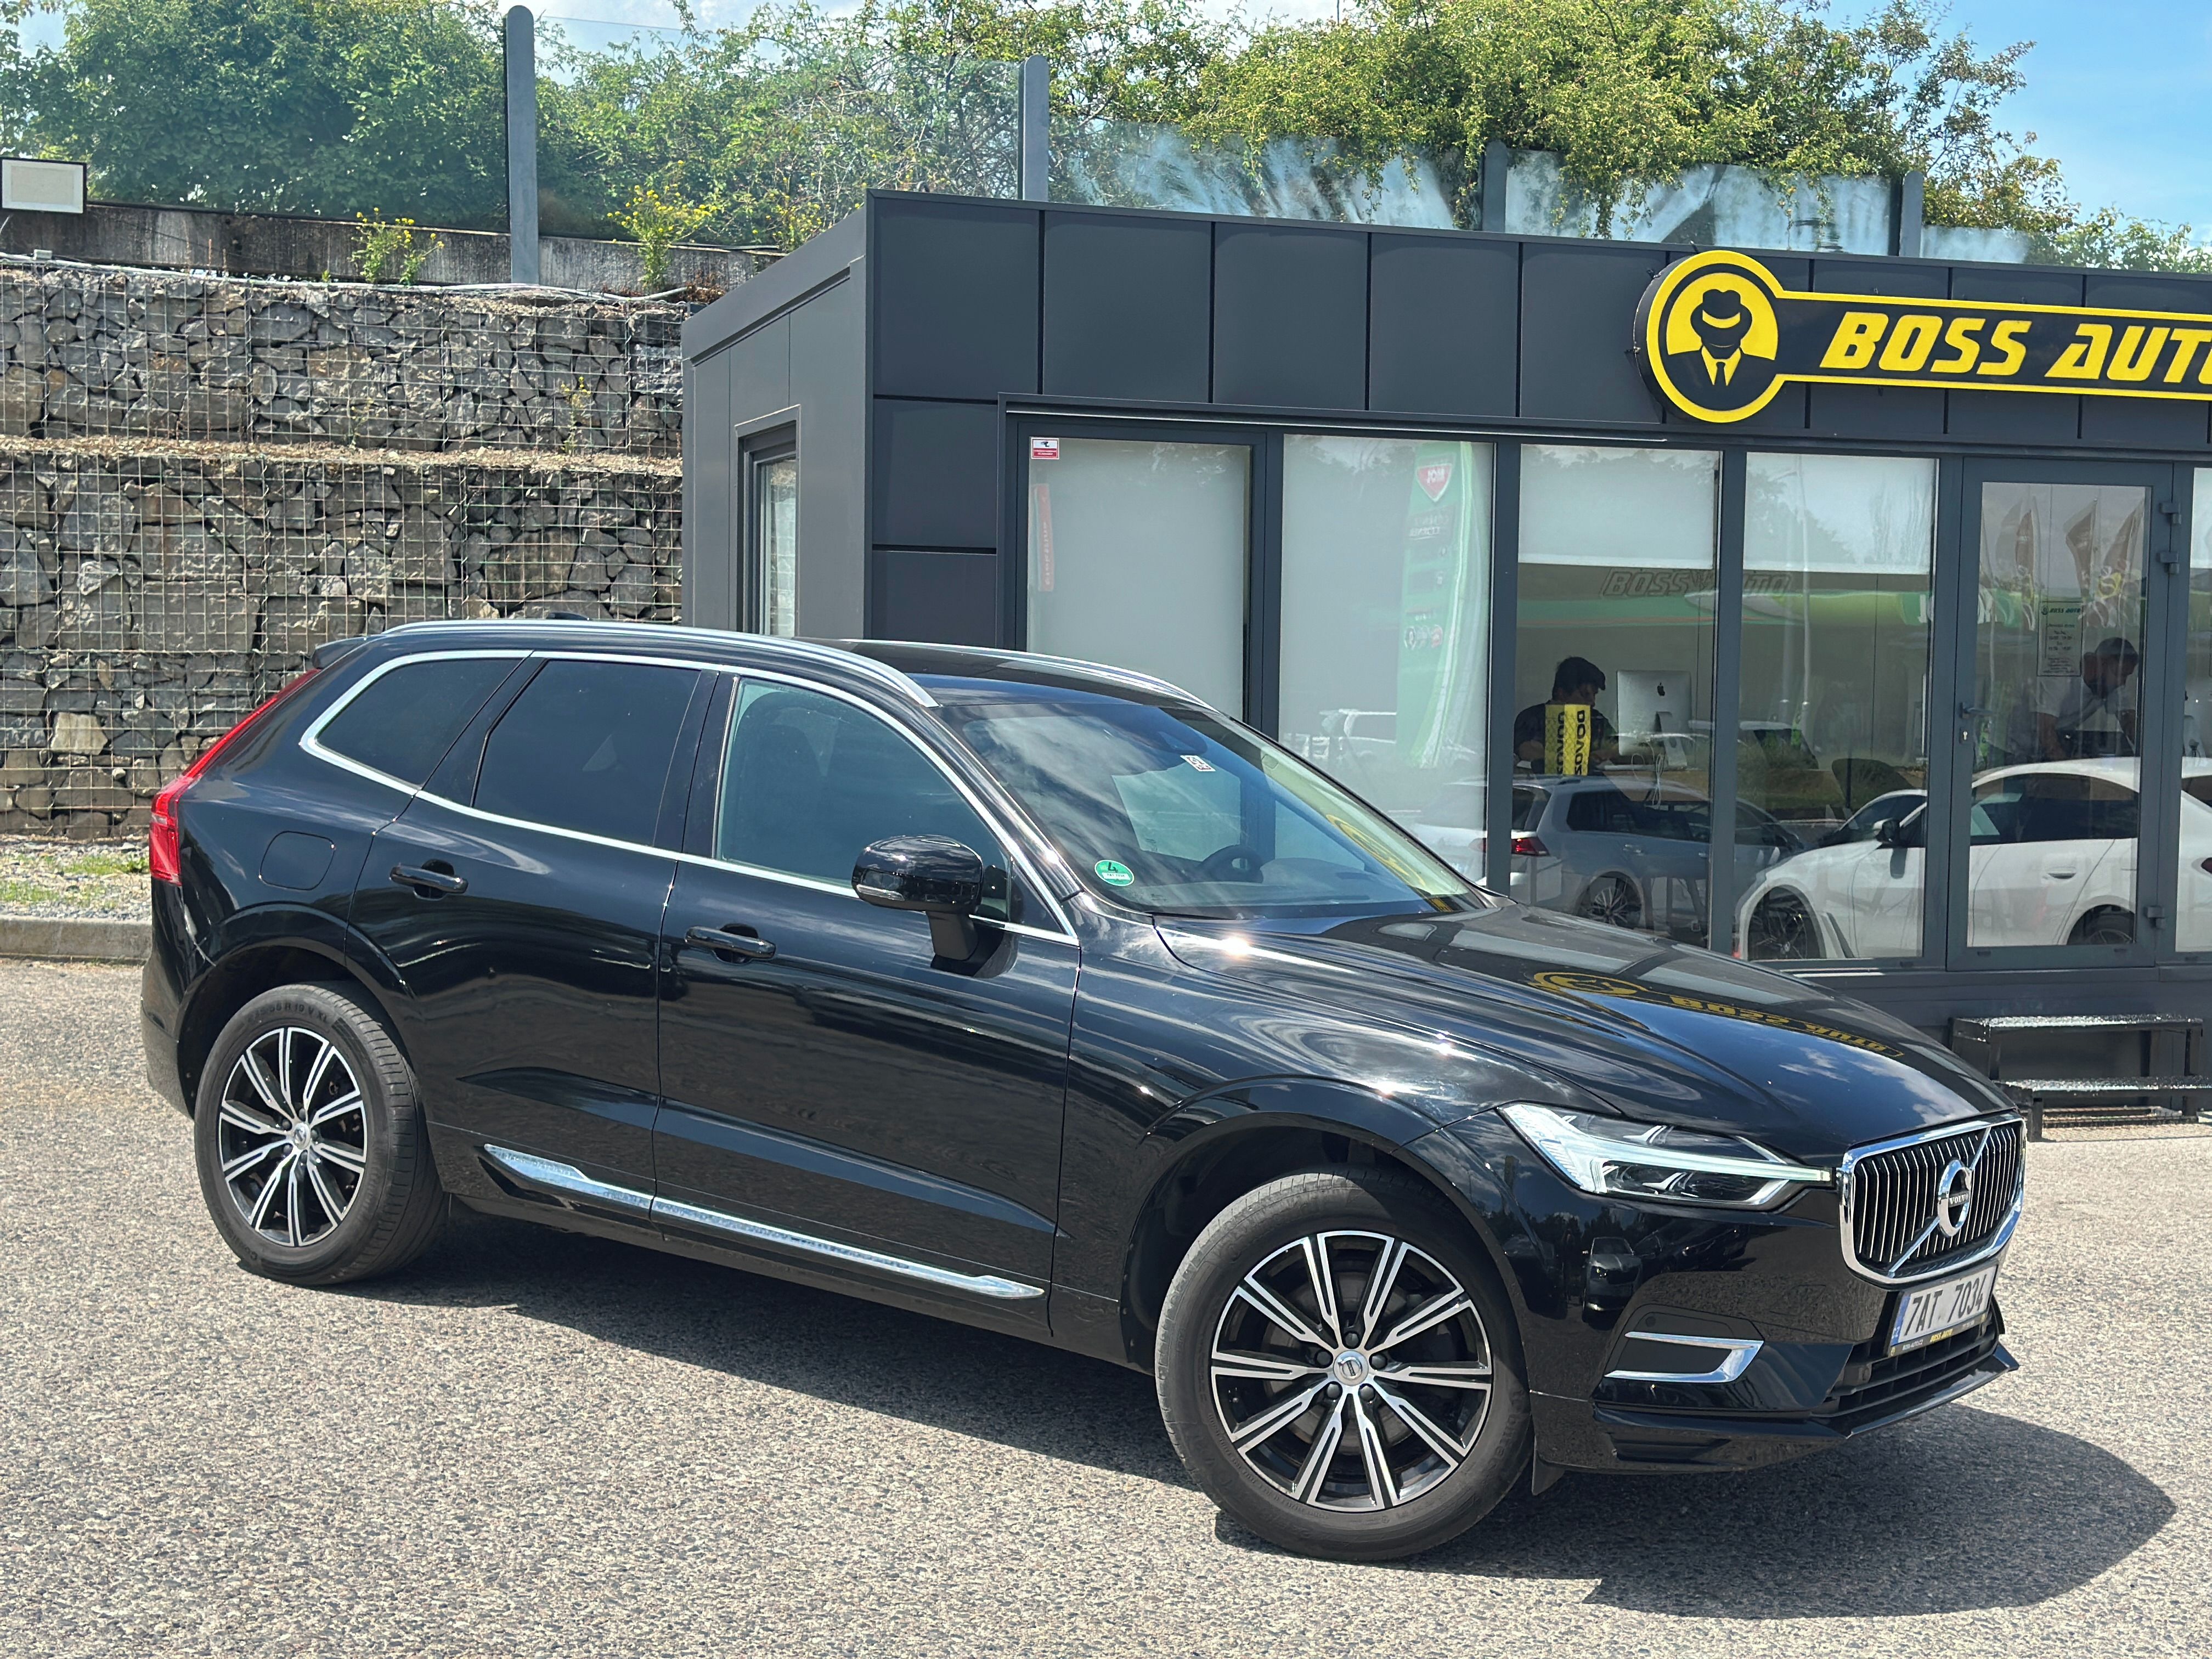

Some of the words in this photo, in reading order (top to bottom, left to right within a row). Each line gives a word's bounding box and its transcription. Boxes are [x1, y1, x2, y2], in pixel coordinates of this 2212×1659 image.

[1819, 312, 2032, 376] BOSS
[2045, 324, 2212, 385] AUT
[1603, 571, 1692, 596] BOSS
[1949, 1193, 1969, 1205] VOLVO
[1904, 1289, 1943, 1336] 7AT
[1947, 1273, 1987, 1323] 7034
